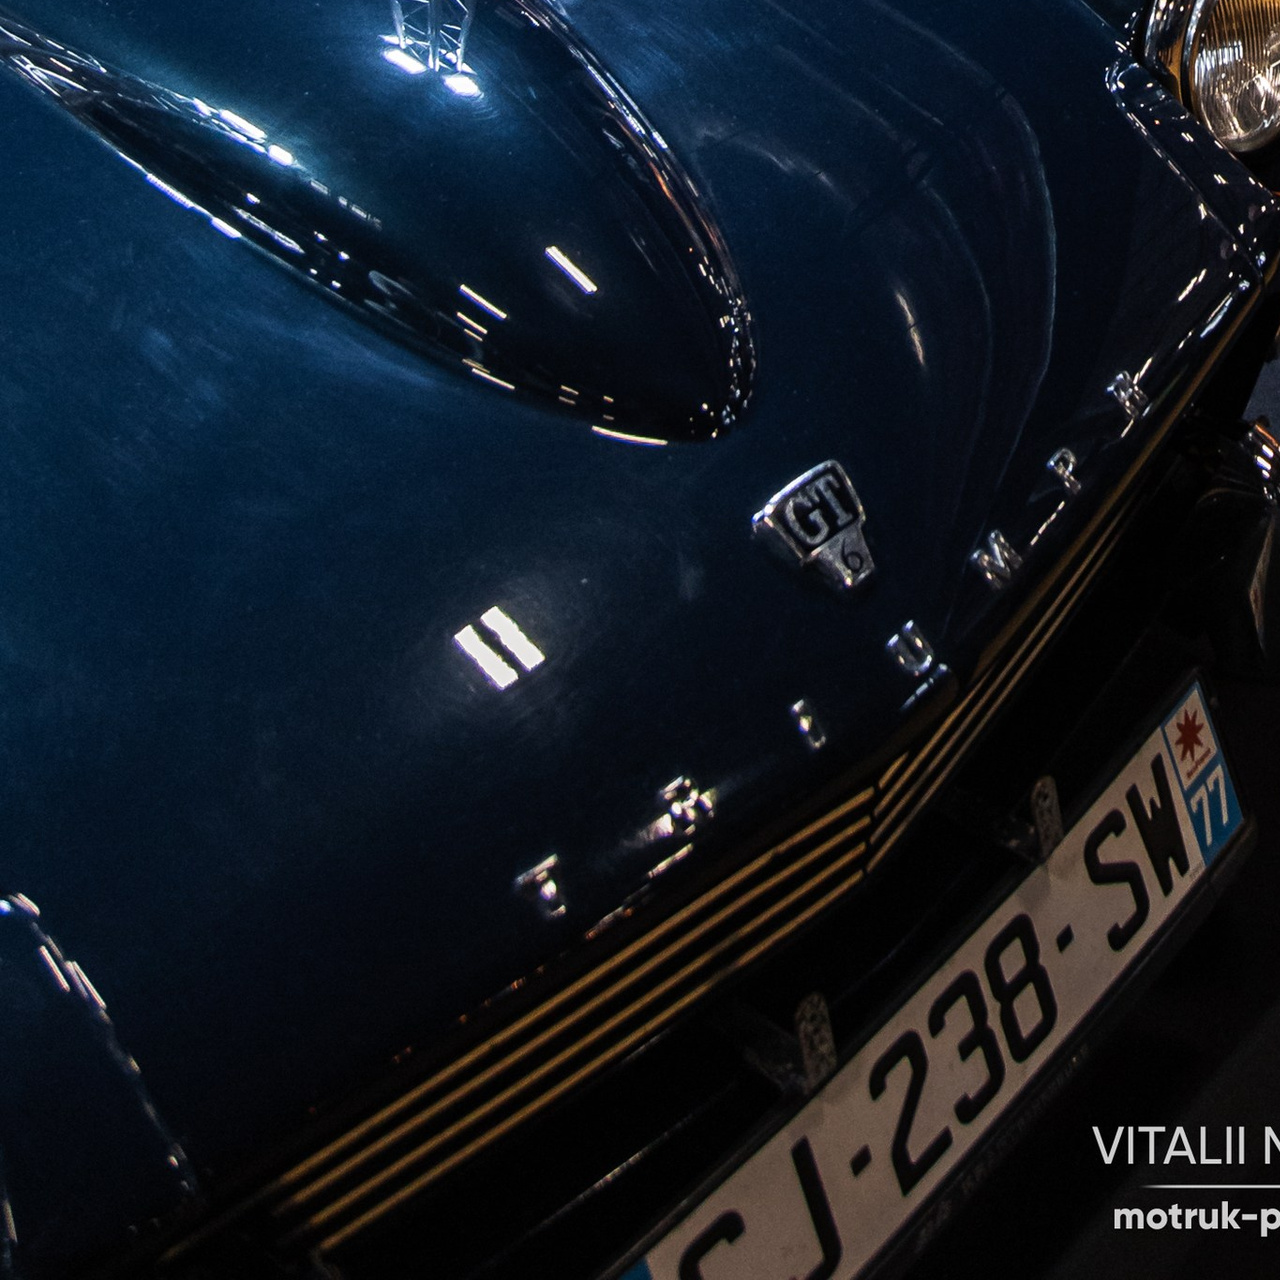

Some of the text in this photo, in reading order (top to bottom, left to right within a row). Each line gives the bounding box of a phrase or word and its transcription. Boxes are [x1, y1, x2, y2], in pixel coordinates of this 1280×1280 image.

[785, 472, 854, 546] GT
[841, 537, 863, 573] 6
[1190, 762, 1228, 847] 77
